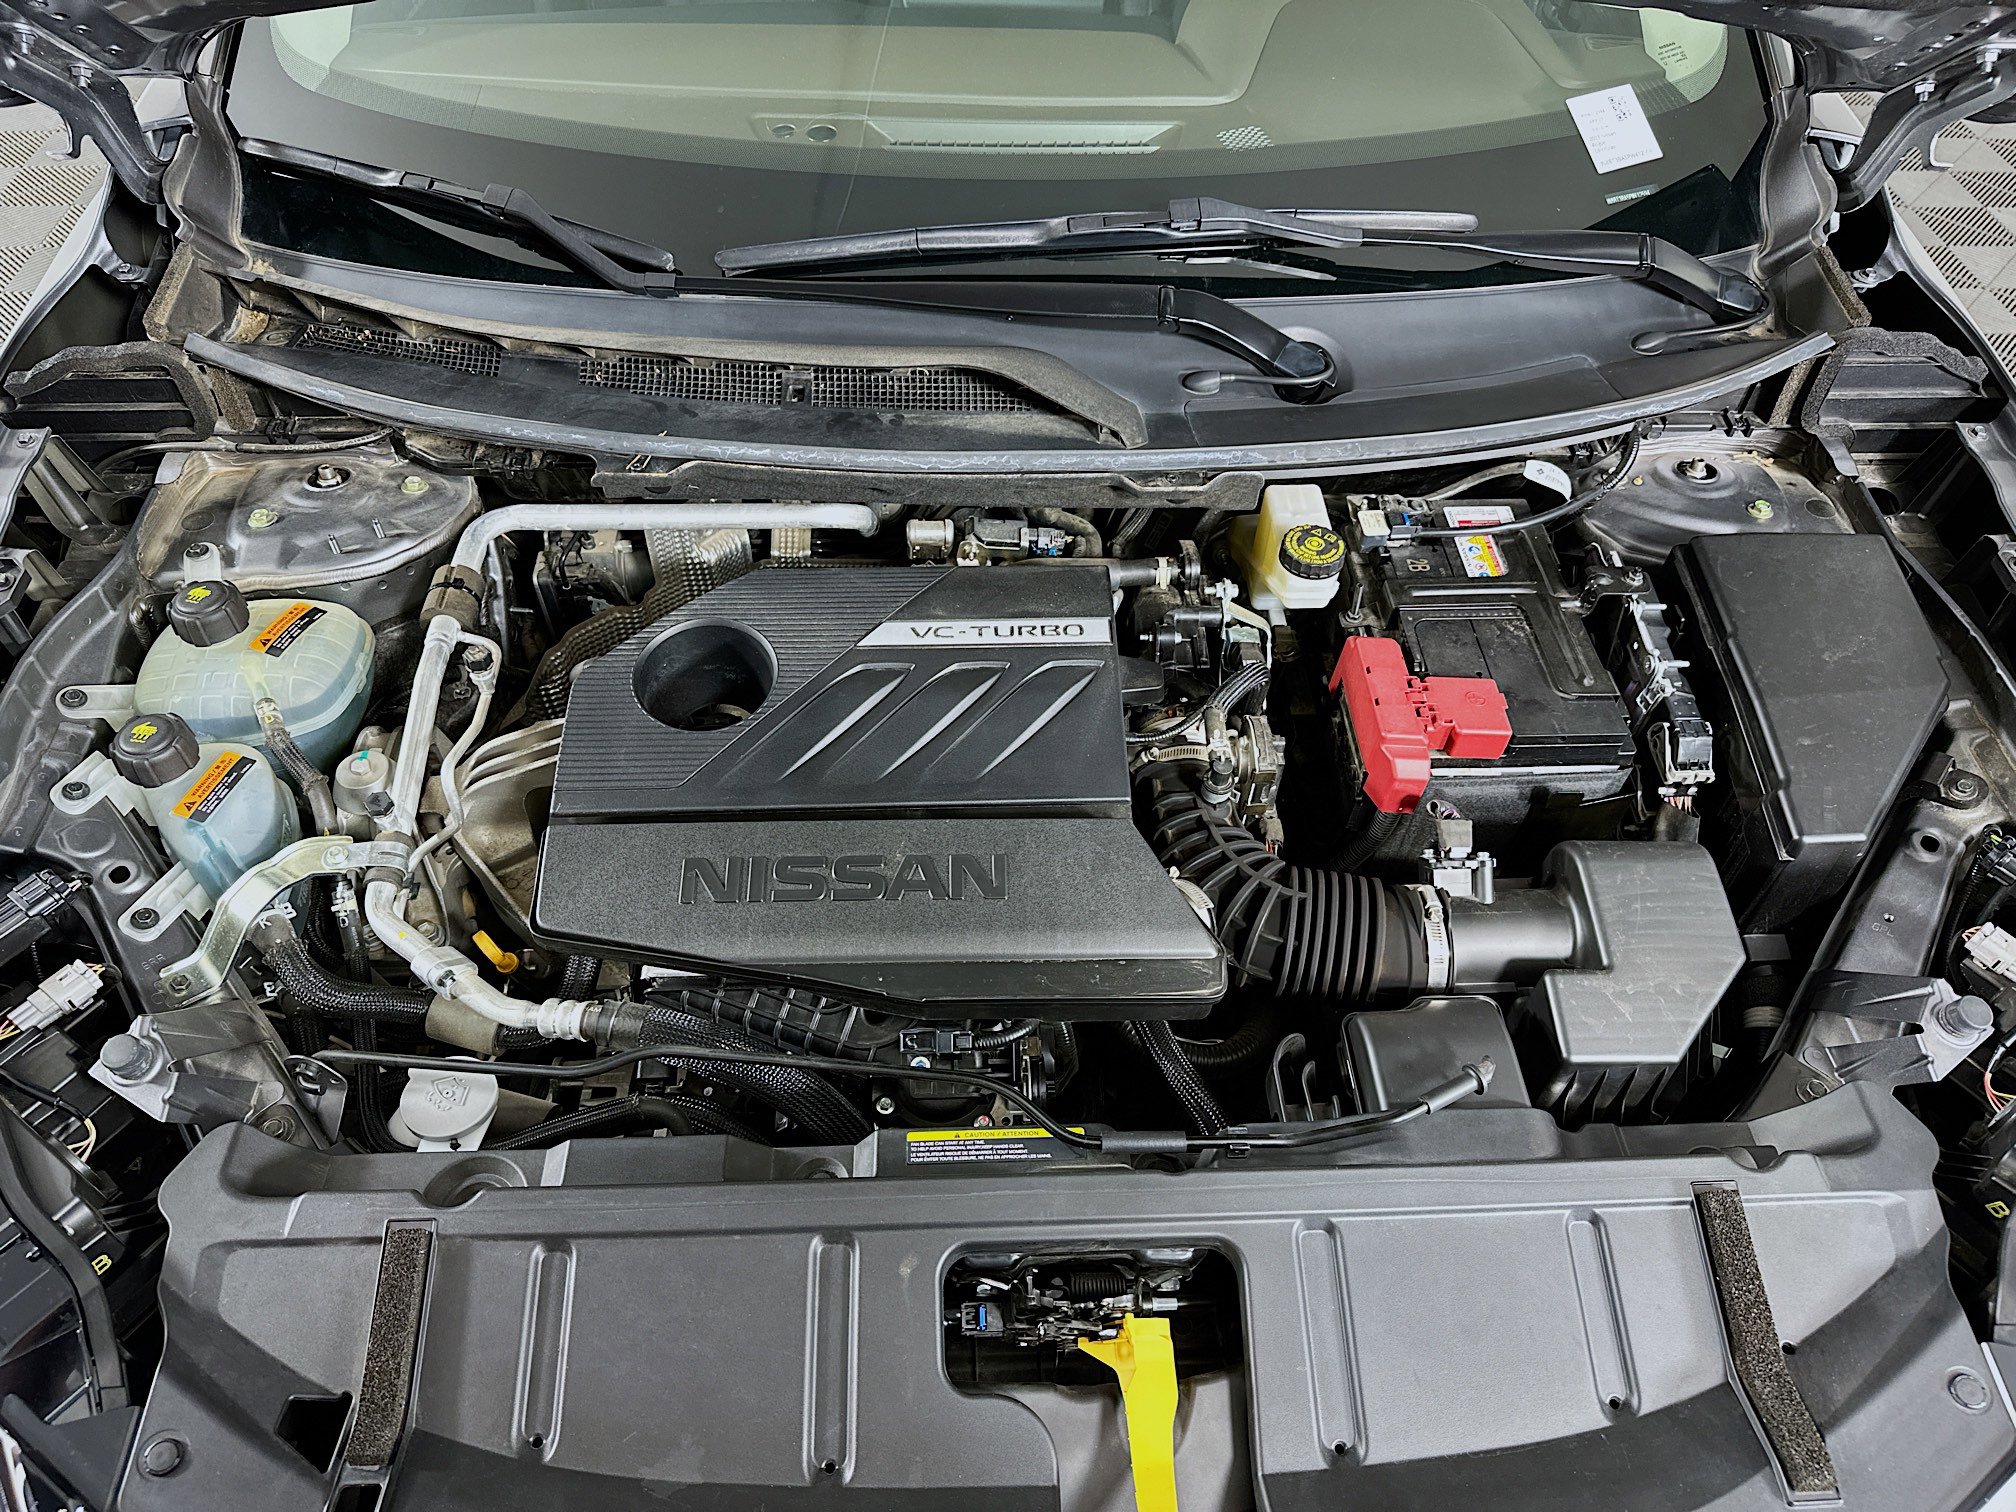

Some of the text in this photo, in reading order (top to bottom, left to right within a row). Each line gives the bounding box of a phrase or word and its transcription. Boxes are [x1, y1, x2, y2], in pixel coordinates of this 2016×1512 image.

[910, 623, 1085, 639] VC-TURBO
[191, 773, 214, 796] WARNING
[197, 758, 234, 799] AVERTISSEMENT
[678, 854, 1008, 904] NISSAN
[1985, 1201, 2010, 1218] B
[91, 1254, 112, 1276] B
